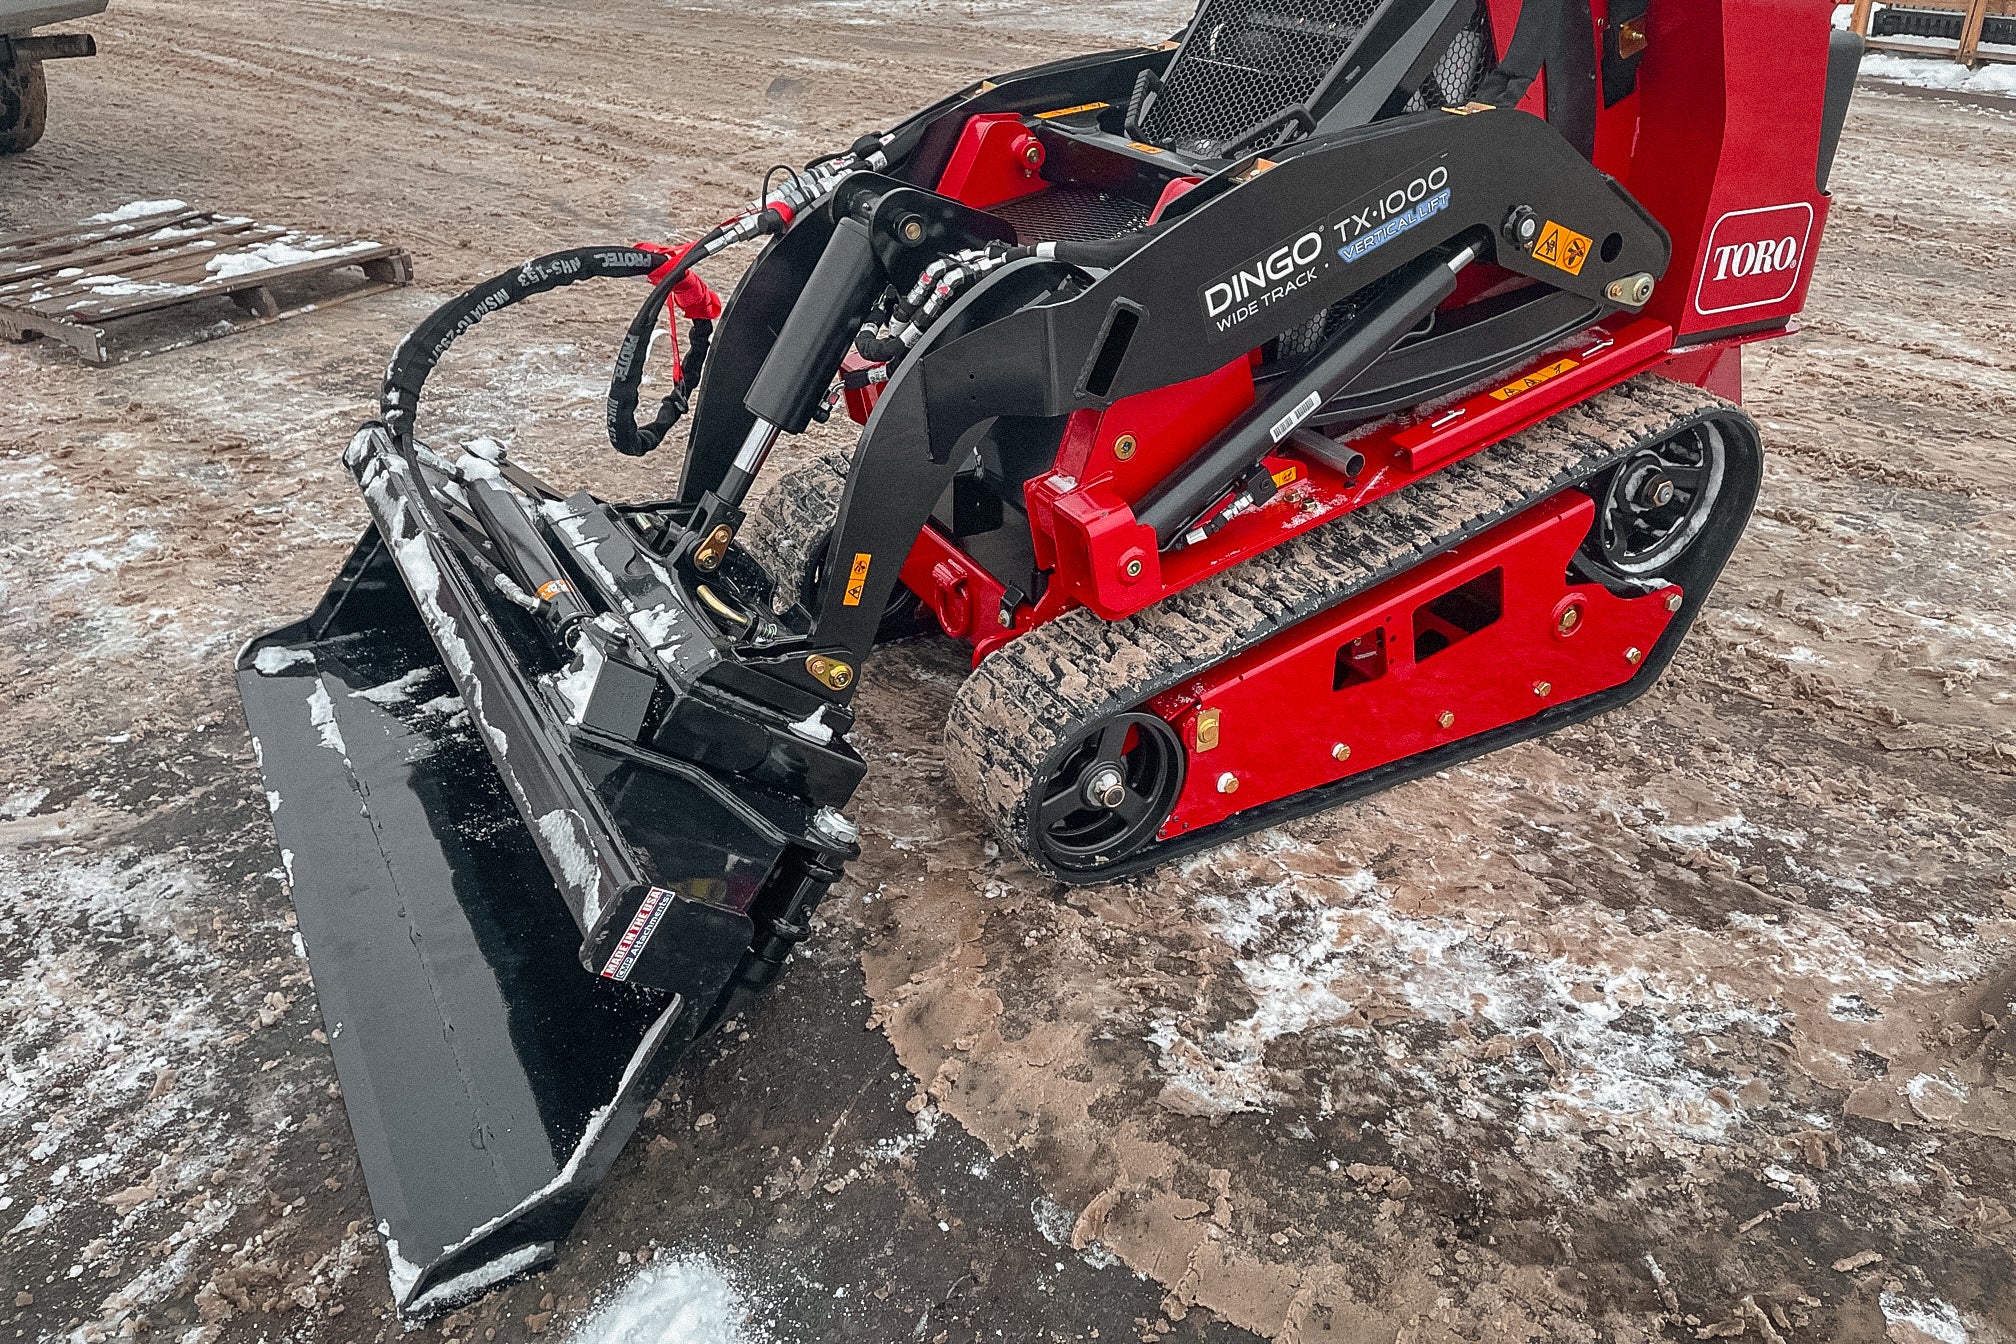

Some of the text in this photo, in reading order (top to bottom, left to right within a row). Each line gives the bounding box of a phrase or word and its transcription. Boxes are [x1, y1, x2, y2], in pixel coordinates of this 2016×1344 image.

[1342, 192, 1448, 259] VERTICAL LIFT
[1712, 236, 1797, 281] TORO
[594, 251, 651, 269] PROTEC
[1204, 231, 1322, 318] DINGO
[1216, 266, 1317, 332] WIDE TRACK
[605, 889, 662, 973] MADE IN THE USA
[630, 895, 671, 957] Attachments
